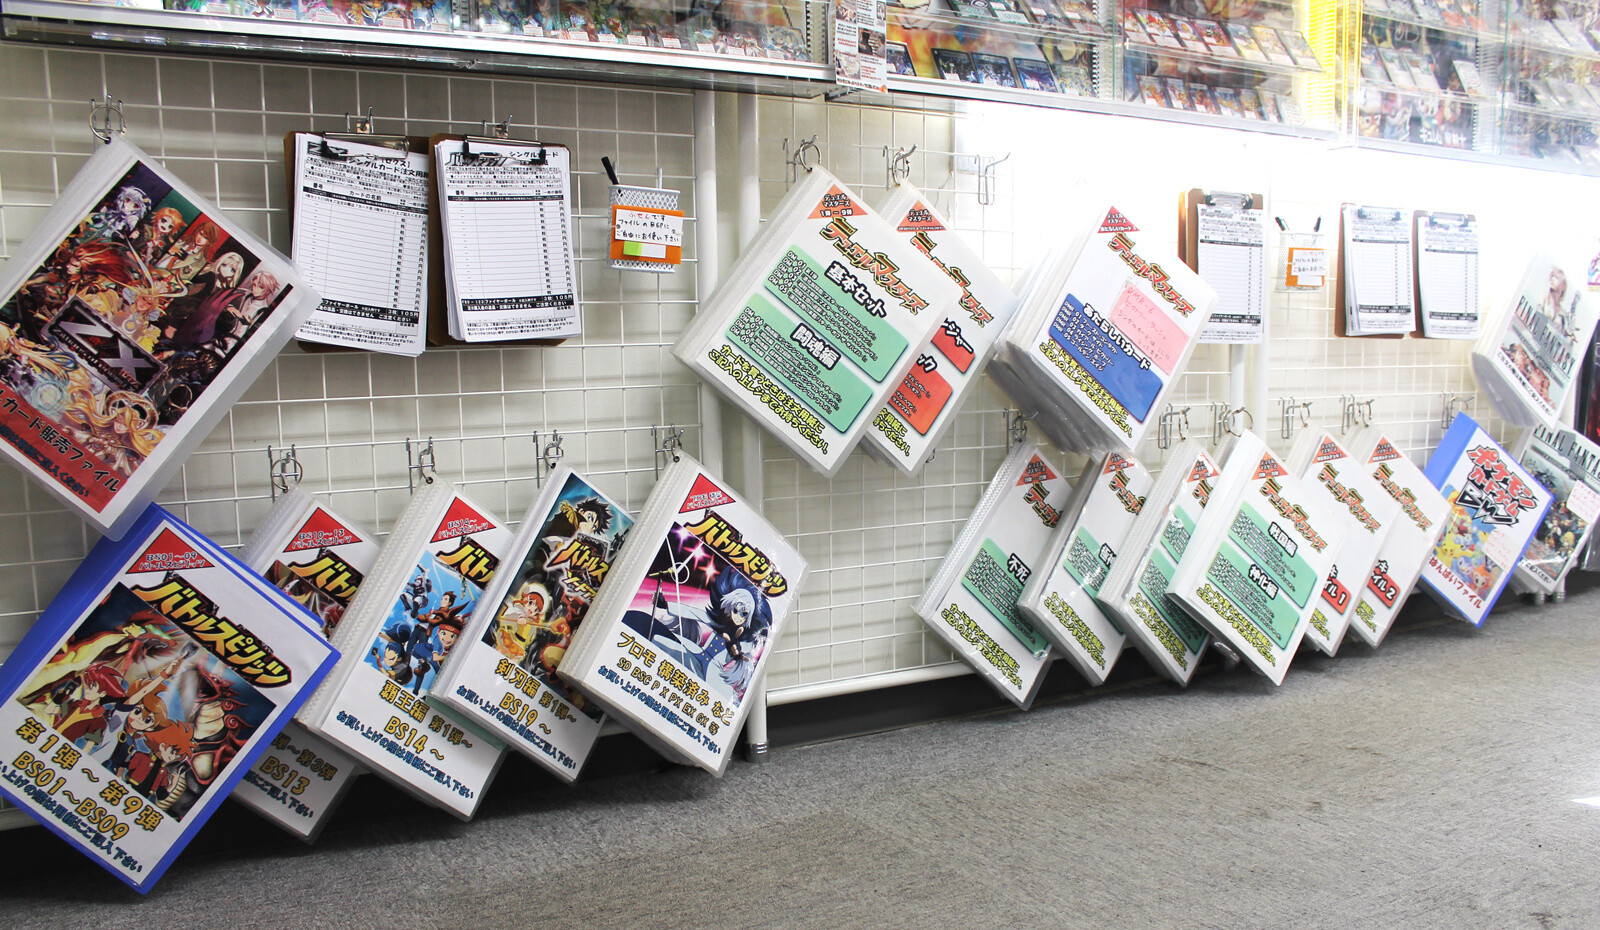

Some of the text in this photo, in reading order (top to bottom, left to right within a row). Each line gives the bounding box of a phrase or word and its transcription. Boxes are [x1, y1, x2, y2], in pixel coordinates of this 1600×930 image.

[824, 260, 887, 319] 基本セット
[790, 322, 842, 370] 闘魂編
[1082, 302, 1151, 371] あたらしいカード
[720, 344, 826, 433] カードを買うときは注文用紙に
[1468, 446, 1537, 509] ポケモン
[1569, 439, 1600, 480] FANTA
[1456, 481, 1519, 525] BW
[1470, 466, 1519, 517] カードゲーム
[146, 551, 197, 562] BS01～09
[683, 515, 788, 598] バトルスピリッツ
[1248, 563, 1280, 600] 神化編
[1429, 556, 1483, 609] はんばいファイル
[130, 578, 293, 689] バトルスピリッツ
[494, 657, 541, 701] 剣刃編
[616, 631, 657, 668] プロモ
[656, 659, 709, 707] 構築済み
[629, 666, 653, 686] BSC
[650, 679, 661, 692] P
[658, 685, 670, 698] X
[666, 691, 684, 709] PX
[680, 701, 697, 718] EX
[378, 679, 430, 723] 覇王編
[500, 692, 539, 729] BS19
[383, 715, 427, 755] BS14
[13, 752, 130, 842] BS01～BS09
[16, 717, 78, 771] 第1弾
[99, 781, 165, 833] 第9弾
[259, 756, 311, 797] BS13
